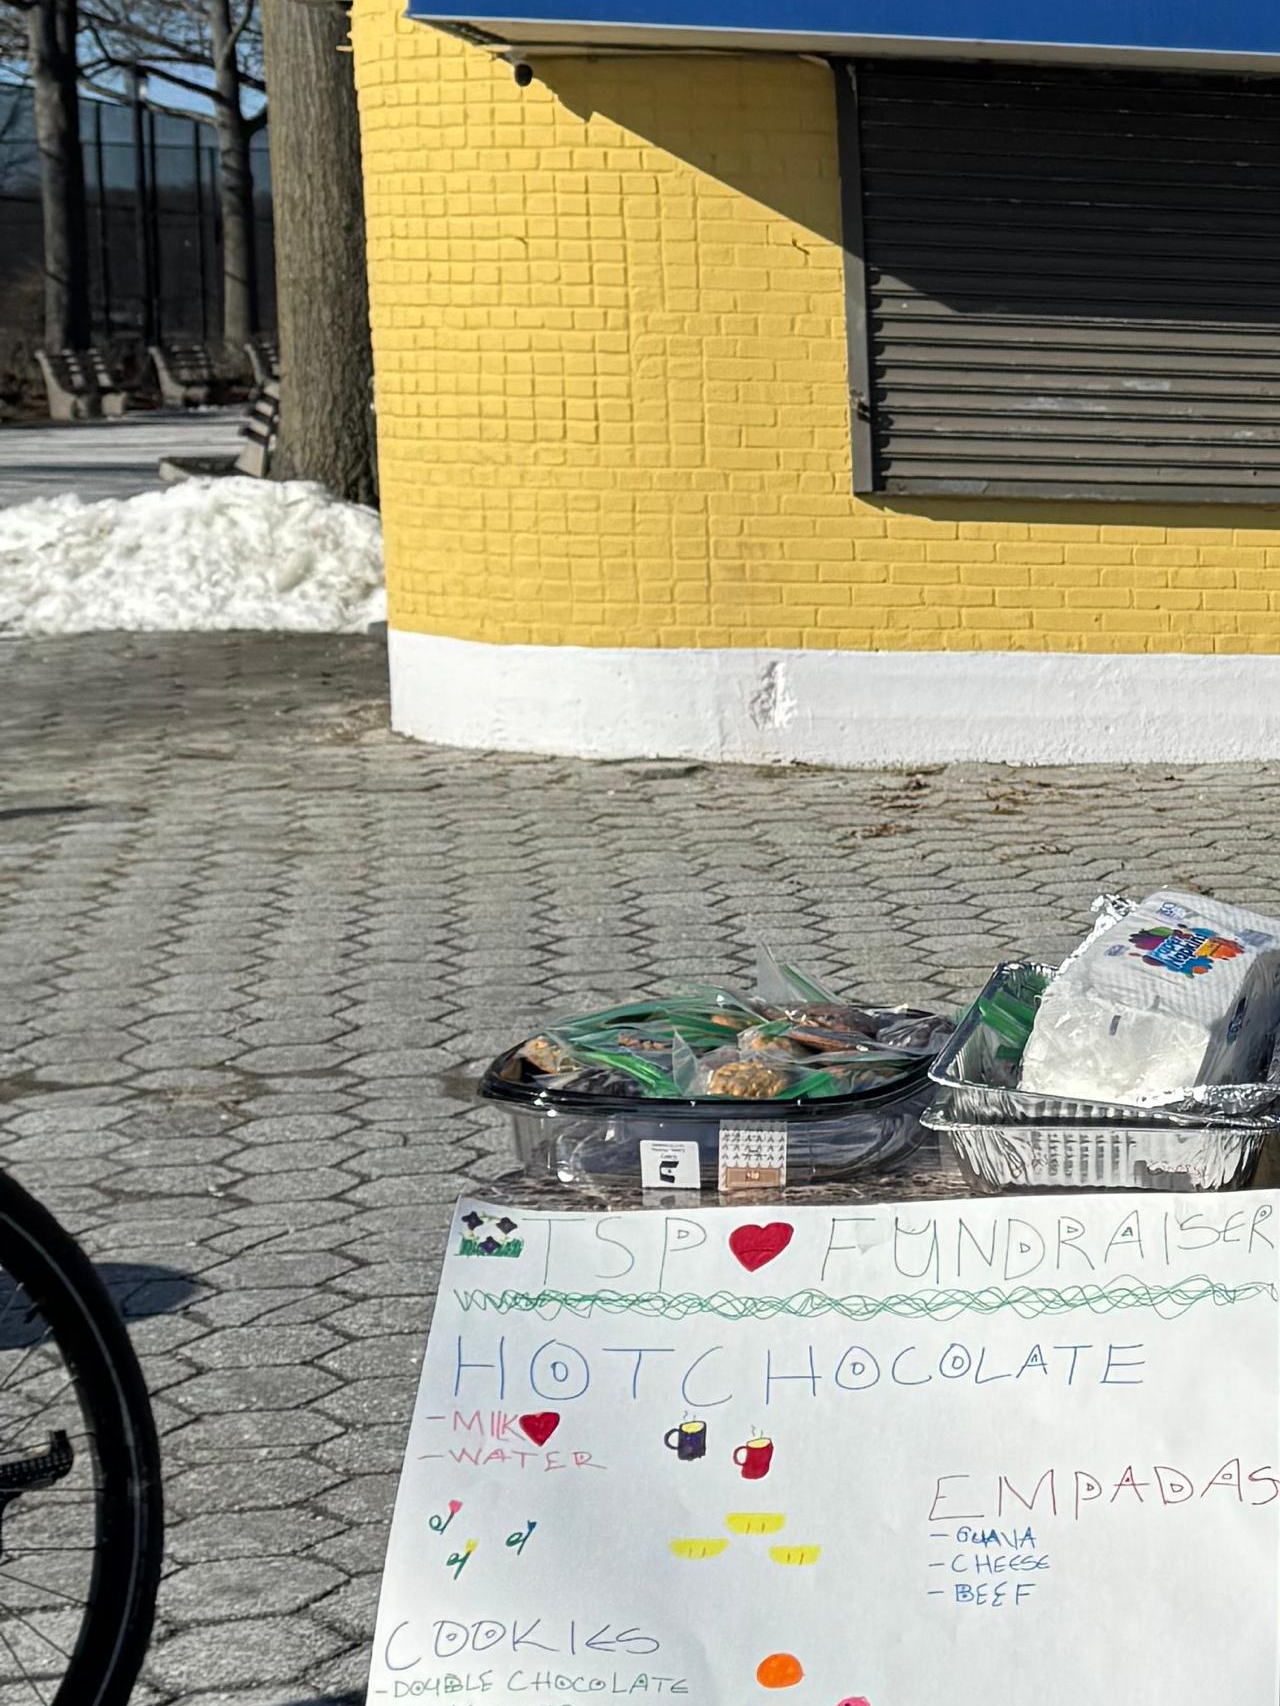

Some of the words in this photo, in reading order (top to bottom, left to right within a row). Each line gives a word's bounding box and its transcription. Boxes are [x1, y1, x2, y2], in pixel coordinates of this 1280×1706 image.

[522, 1215, 708, 1292] TSP
[820, 1203, 1275, 1286] FUNDRAISER
[928, 1457, 1280, 1521] EMPADAS
[506, 1671, 690, 1694] CHOCOLATE
